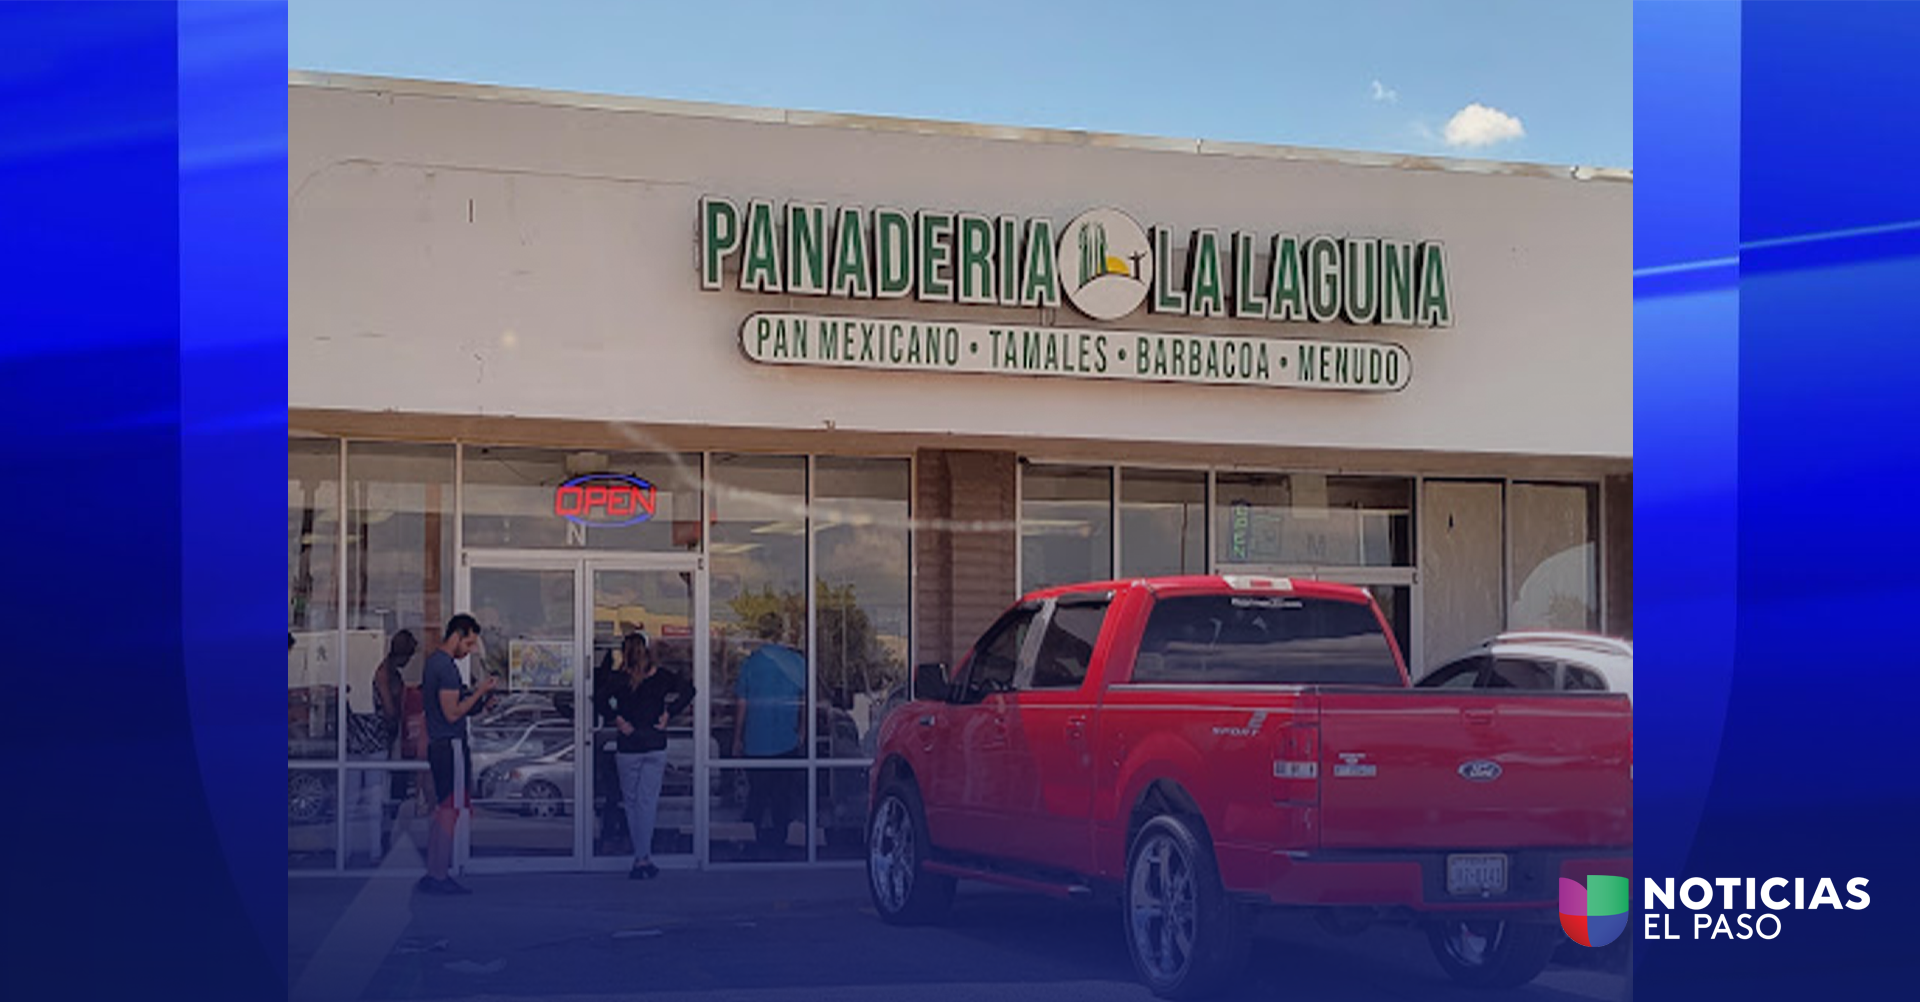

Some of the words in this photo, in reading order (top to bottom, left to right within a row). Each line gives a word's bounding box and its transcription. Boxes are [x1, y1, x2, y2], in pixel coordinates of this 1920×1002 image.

[702, 196, 1060, 308] PANADERIA
[1155, 225, 1225, 317] LA
[1236, 230, 1453, 326] LAGUNA
[756, 318, 808, 358] PAN
[818, 321, 960, 366] MEXICANO
[989, 330, 1108, 373] TAMALES
[1136, 336, 1270, 379] BARBACOA
[1298, 345, 1400, 385] MENUDO
[555, 485, 657, 516] OPEN
